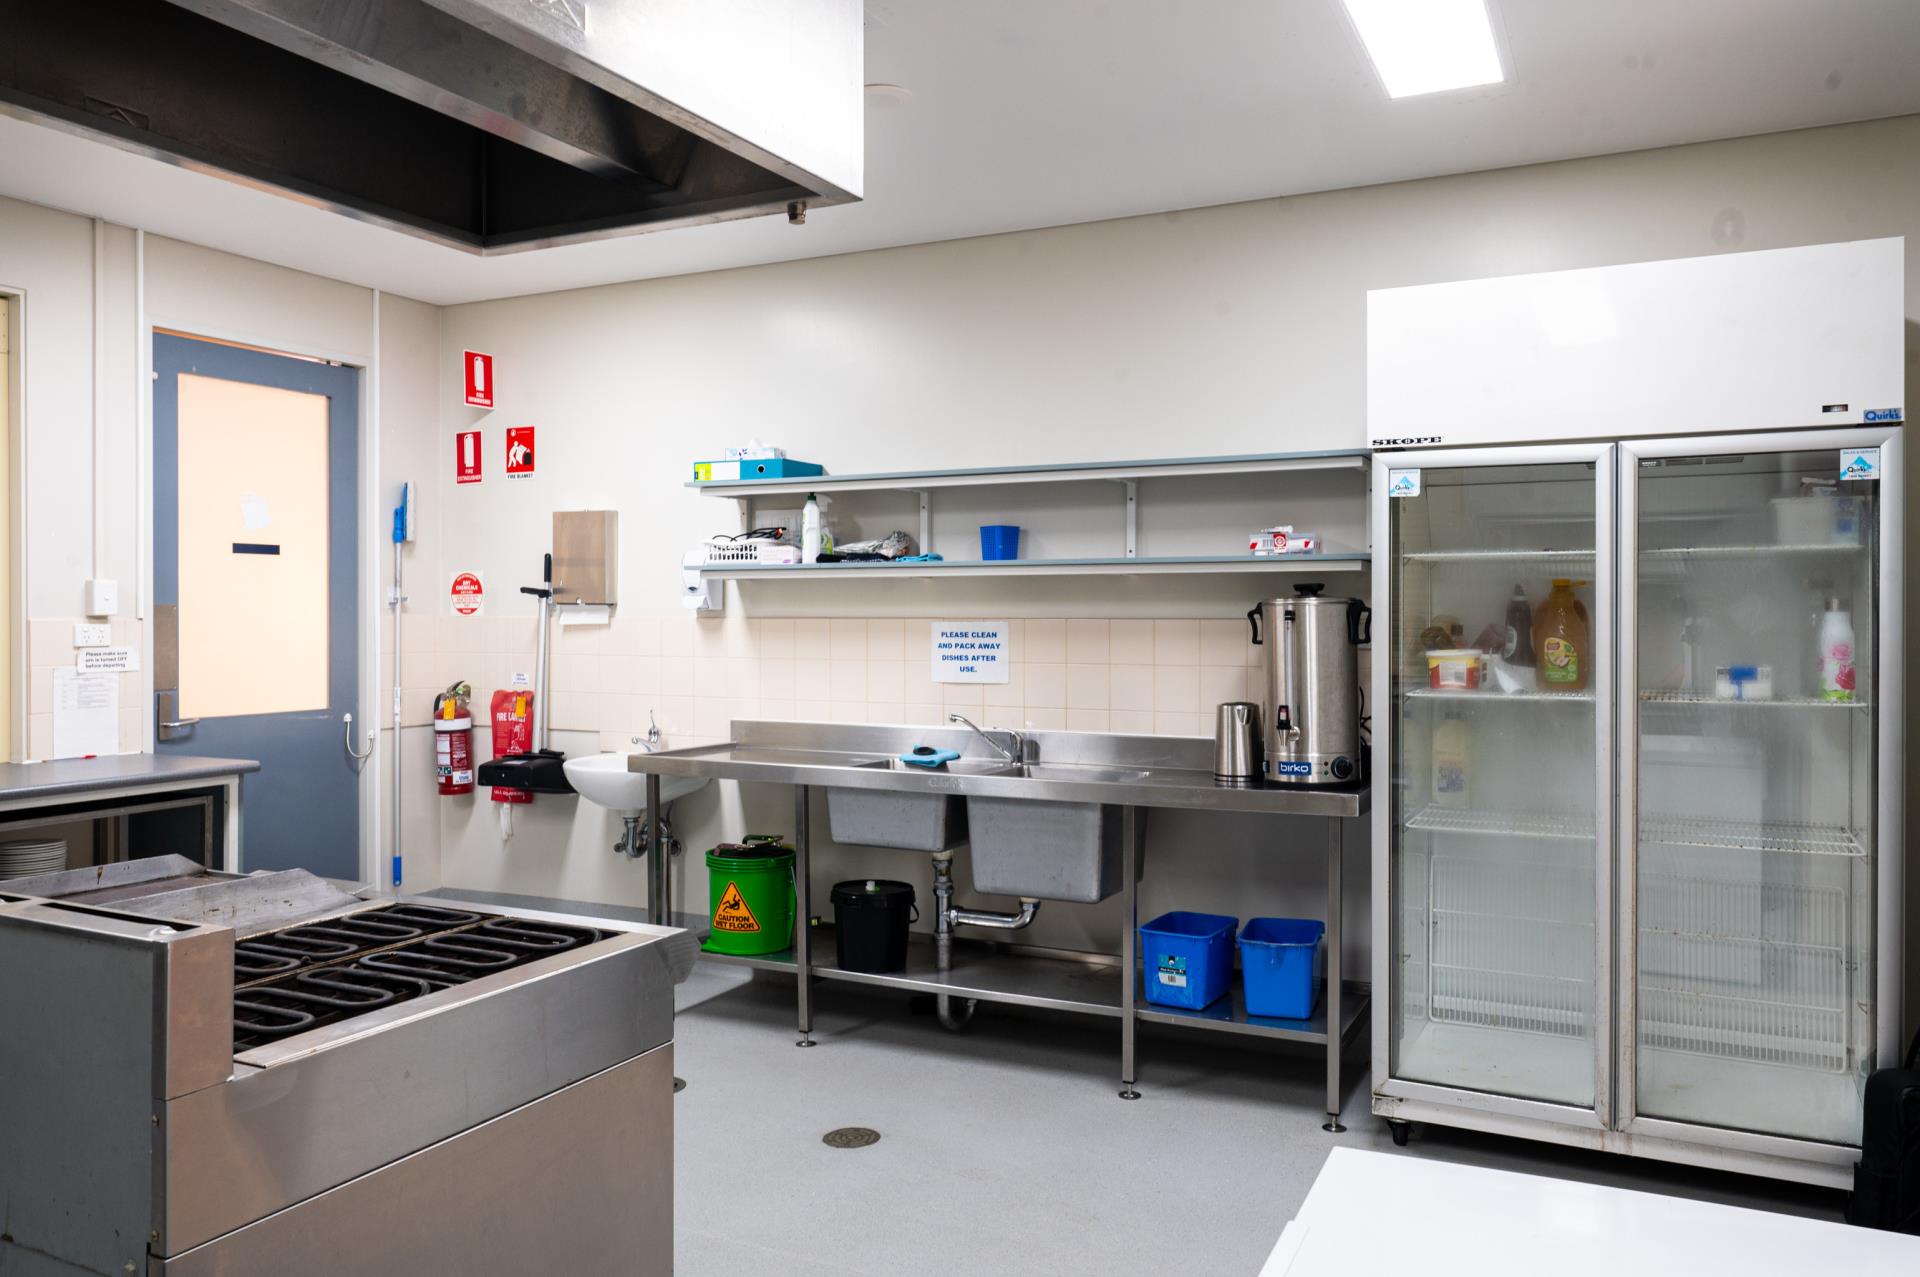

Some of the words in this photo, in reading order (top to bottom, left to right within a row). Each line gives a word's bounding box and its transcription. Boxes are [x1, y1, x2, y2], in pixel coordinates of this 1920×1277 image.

[1372, 436, 1442, 446] SKOPE
[496, 712, 508, 721] FIRE
[1280, 764, 1309, 772] birko
